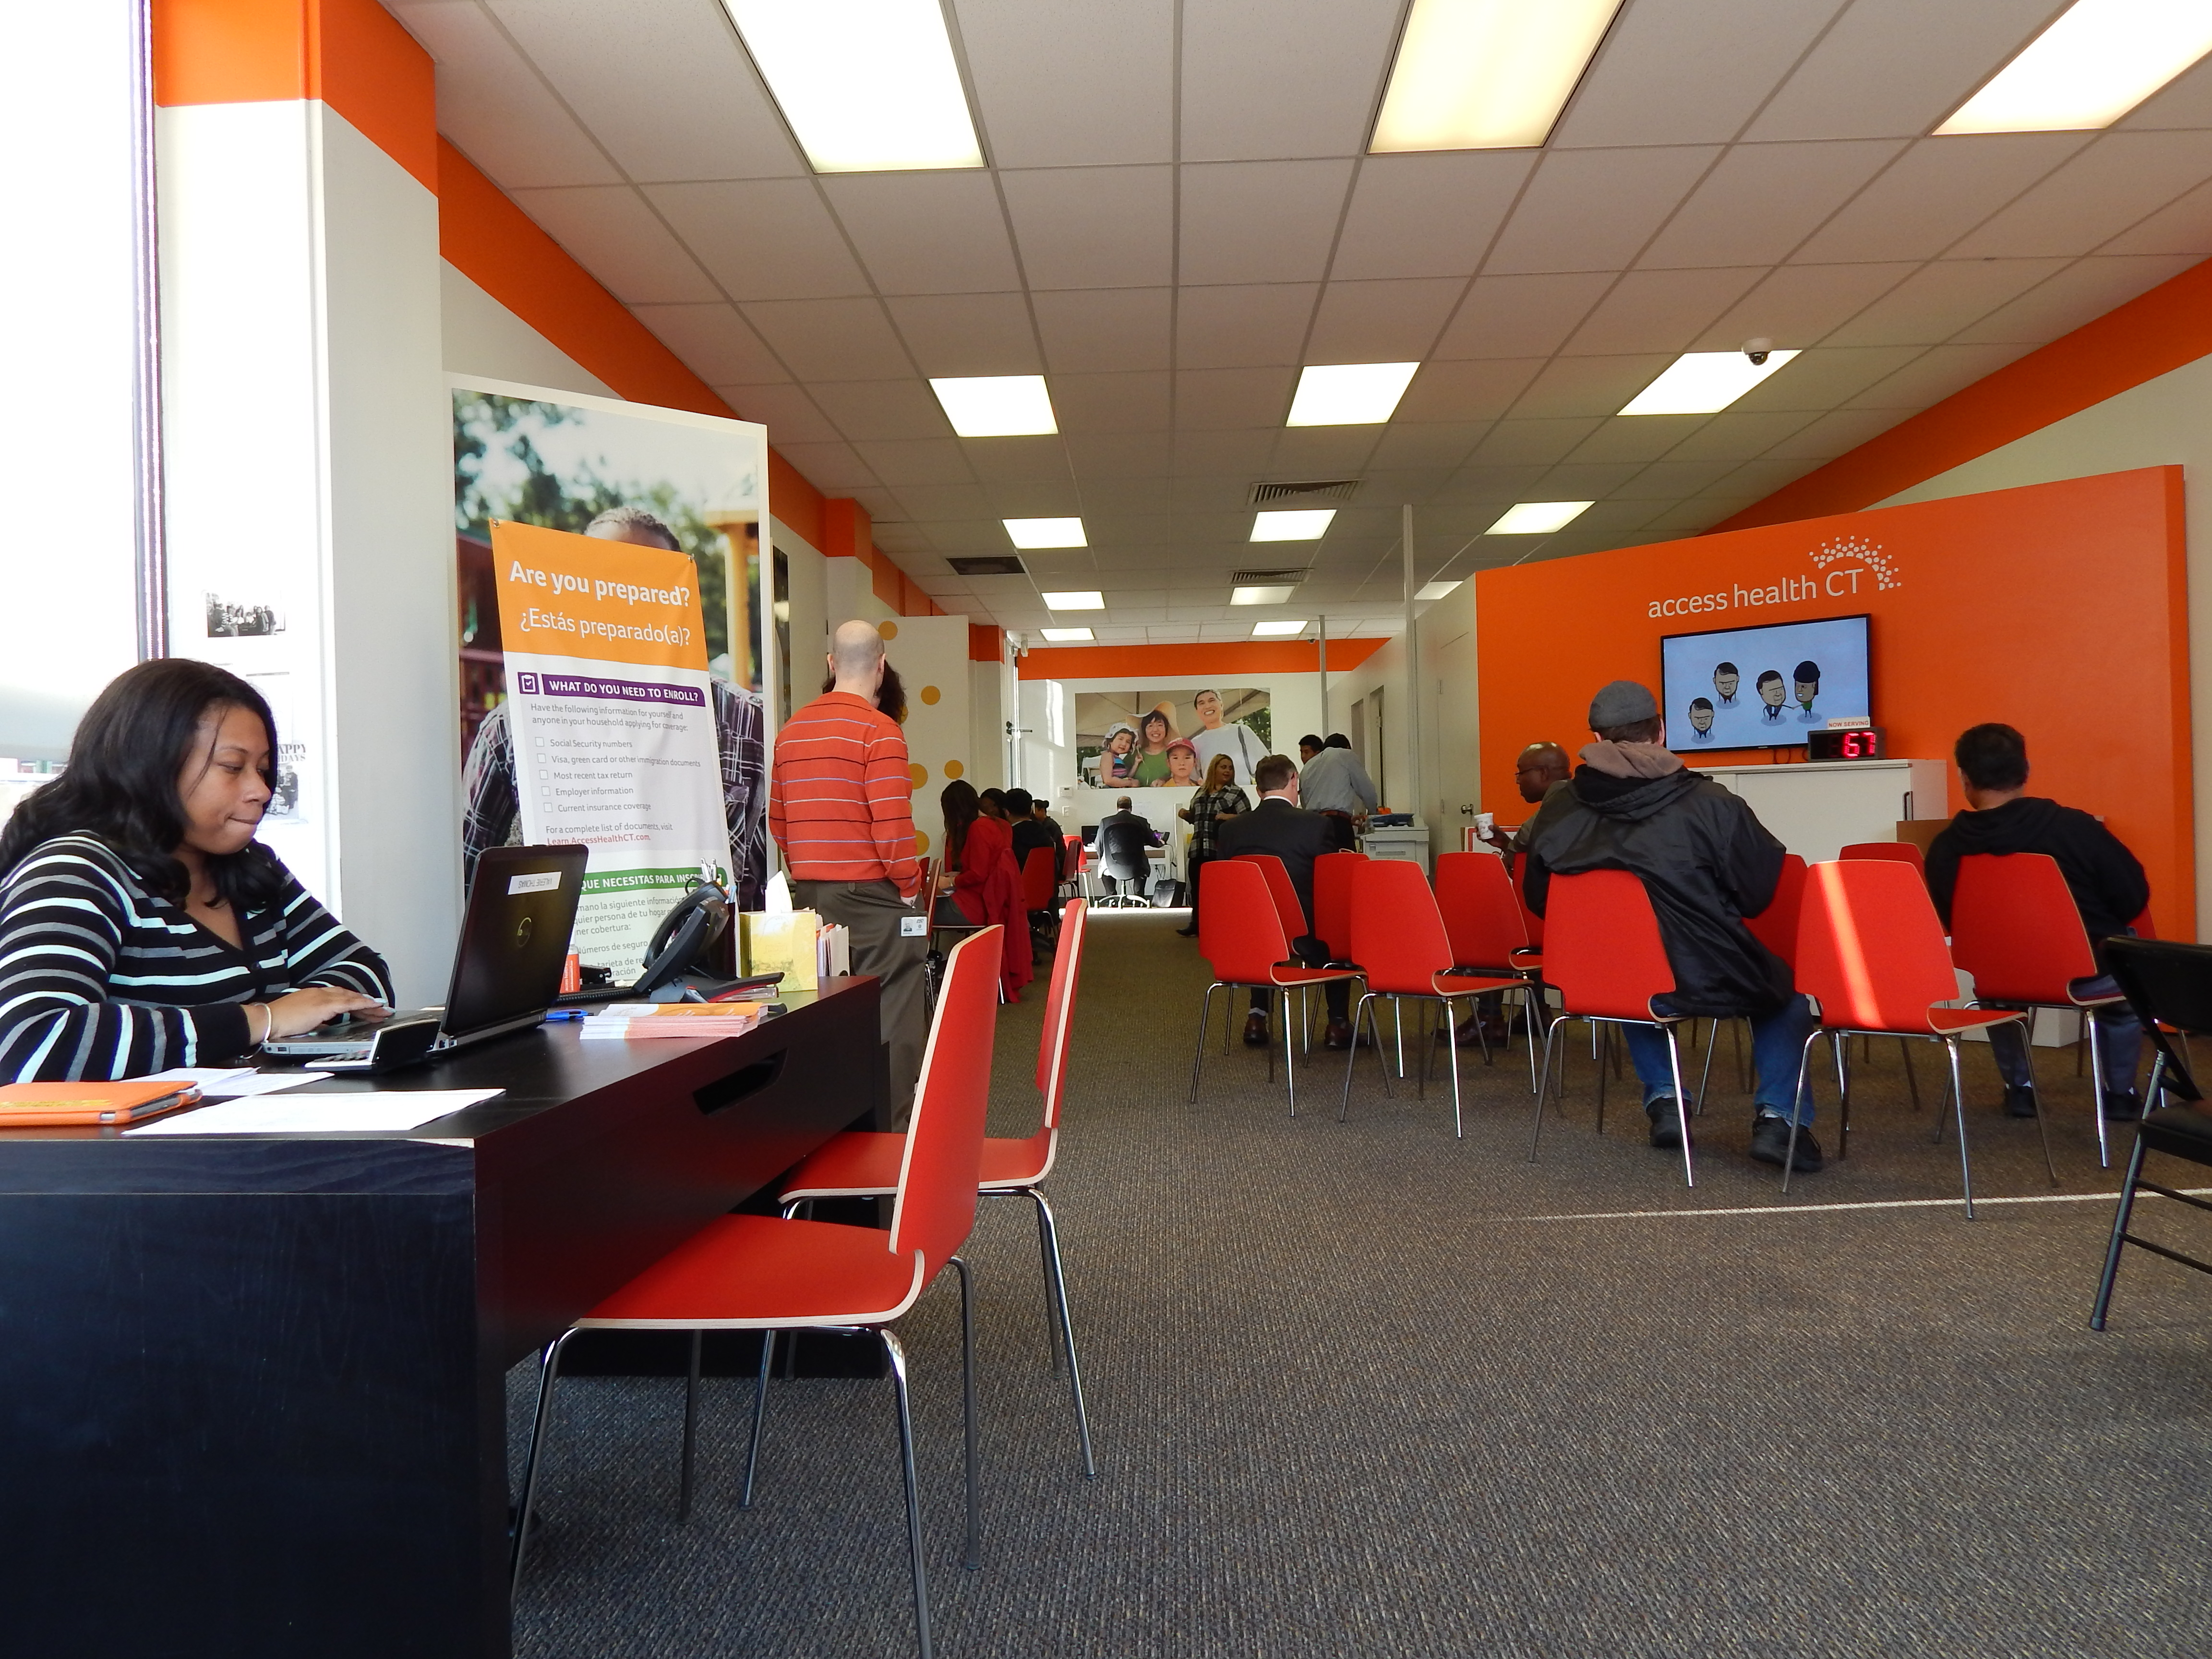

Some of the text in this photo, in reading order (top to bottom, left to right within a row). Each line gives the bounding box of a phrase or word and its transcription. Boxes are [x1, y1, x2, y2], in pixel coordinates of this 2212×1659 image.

[510, 561, 690, 607] Are you prepared?
[1648, 568, 1863, 618] access health CT
[520, 608, 690, 647] ¿Estás preparado(a)?
[549, 681, 698, 701] WHAT DO YOU NEED TO ENROLL?
[530, 703, 551, 712] Have
[552, 704, 563, 712] the
[565, 705, 599, 715] following
[600, 706, 637, 716] information
[649, 710, 672, 719] yourself
[532, 717, 560, 726] anyone
[586, 717, 624, 726] household
[625, 720, 651, 730] applying
[652, 721, 661, 729] for
[662, 723, 688, 732] coverage:
[277, 744, 306, 754] APPY
[550, 739, 572, 747] Social
[573, 740, 601, 749] Security
[1844, 731, 1876, 758] 67
[552, 756, 570, 764] Visa,
[571, 757, 590, 765] green
[592, 755, 608, 763] card
[637, 756, 669, 766] immigration
[671, 758, 701, 767] documents
[555, 786, 634, 797] Employer information
[558, 804, 586, 812] Current
[623, 803, 651, 811] coverage
[546, 826, 557, 834] For
[565, 824, 600, 834] complete
[601, 823, 613, 831] list
[614, 822, 623, 831] of
[624, 822, 661, 831] documents,
[581, 879, 600, 891] QUE
[603, 875, 654, 888] NECESITAS
[655, 875, 674, 884] PARA
[601, 902, 608, 910] la
[609, 899, 646, 911] siguiente
[574, 915, 593, 926] quier
[594, 913, 626, 924] persona
[627, 910, 637, 919] de
[649, 908, 666, 918] hogar
[590, 924, 631, 934] cobertura:
[577, 940, 648, 954] Números de seguro
[598, 958, 623, 968] tarjeta
[625, 958, 634, 966] de
[612, 967, 636, 976] ración
